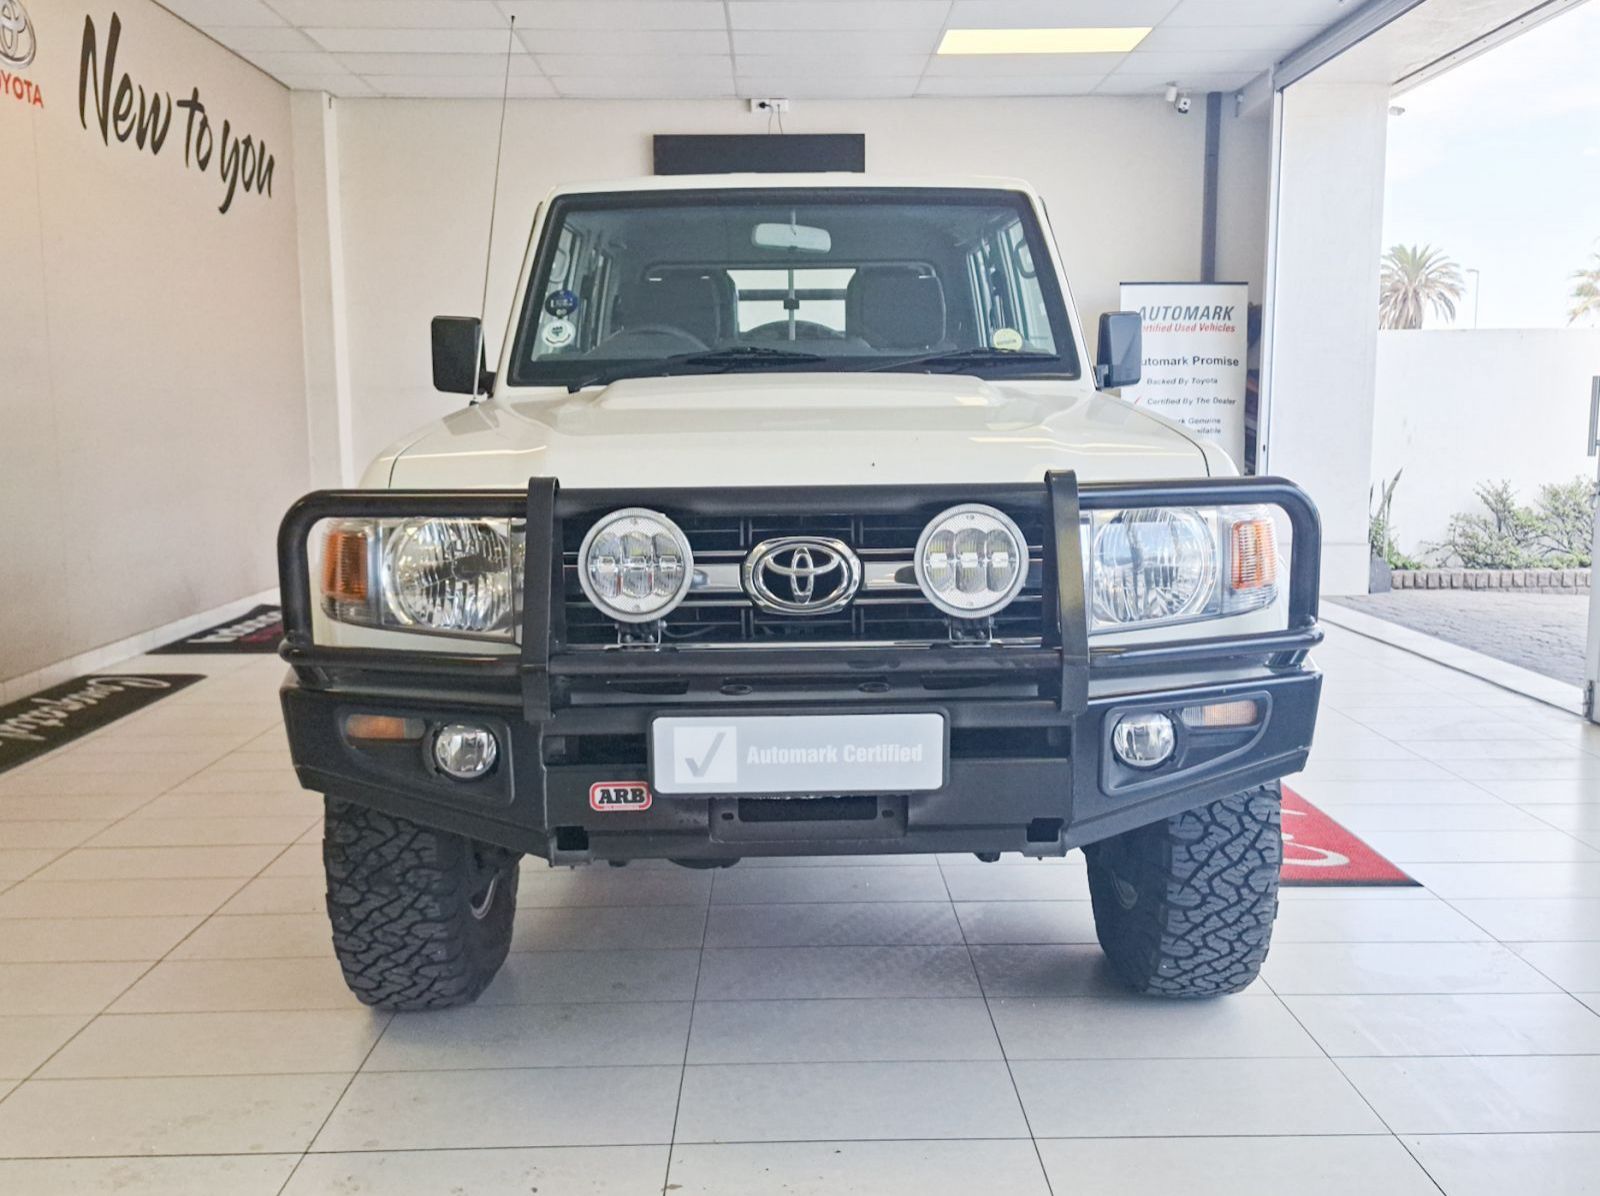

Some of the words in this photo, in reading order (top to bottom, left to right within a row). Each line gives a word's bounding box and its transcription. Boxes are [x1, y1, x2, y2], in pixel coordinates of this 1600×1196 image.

[0, 69, 45, 109] YOTA
[78, 11, 172, 156] New
[176, 86, 213, 172] to
[218, 119, 275, 215] you
[1174, 322, 1197, 332] Used
[1199, 322, 1236, 333] Vehicles
[1142, 355, 1189, 366] utomark
[1192, 355, 1240, 367] Promise
[1146, 377, 1176, 385] Backed
[1178, 377, 1189, 386] By
[1192, 377, 1218, 386] Toyota
[1147, 397, 1181, 405] Certified
[1196, 397, 1211, 405] The
[1213, 396, 1236, 405] Dealer
[746, 745, 838, 765] Automark
[843, 743, 923, 763] Certified
[598, 788, 646, 805] ARB
